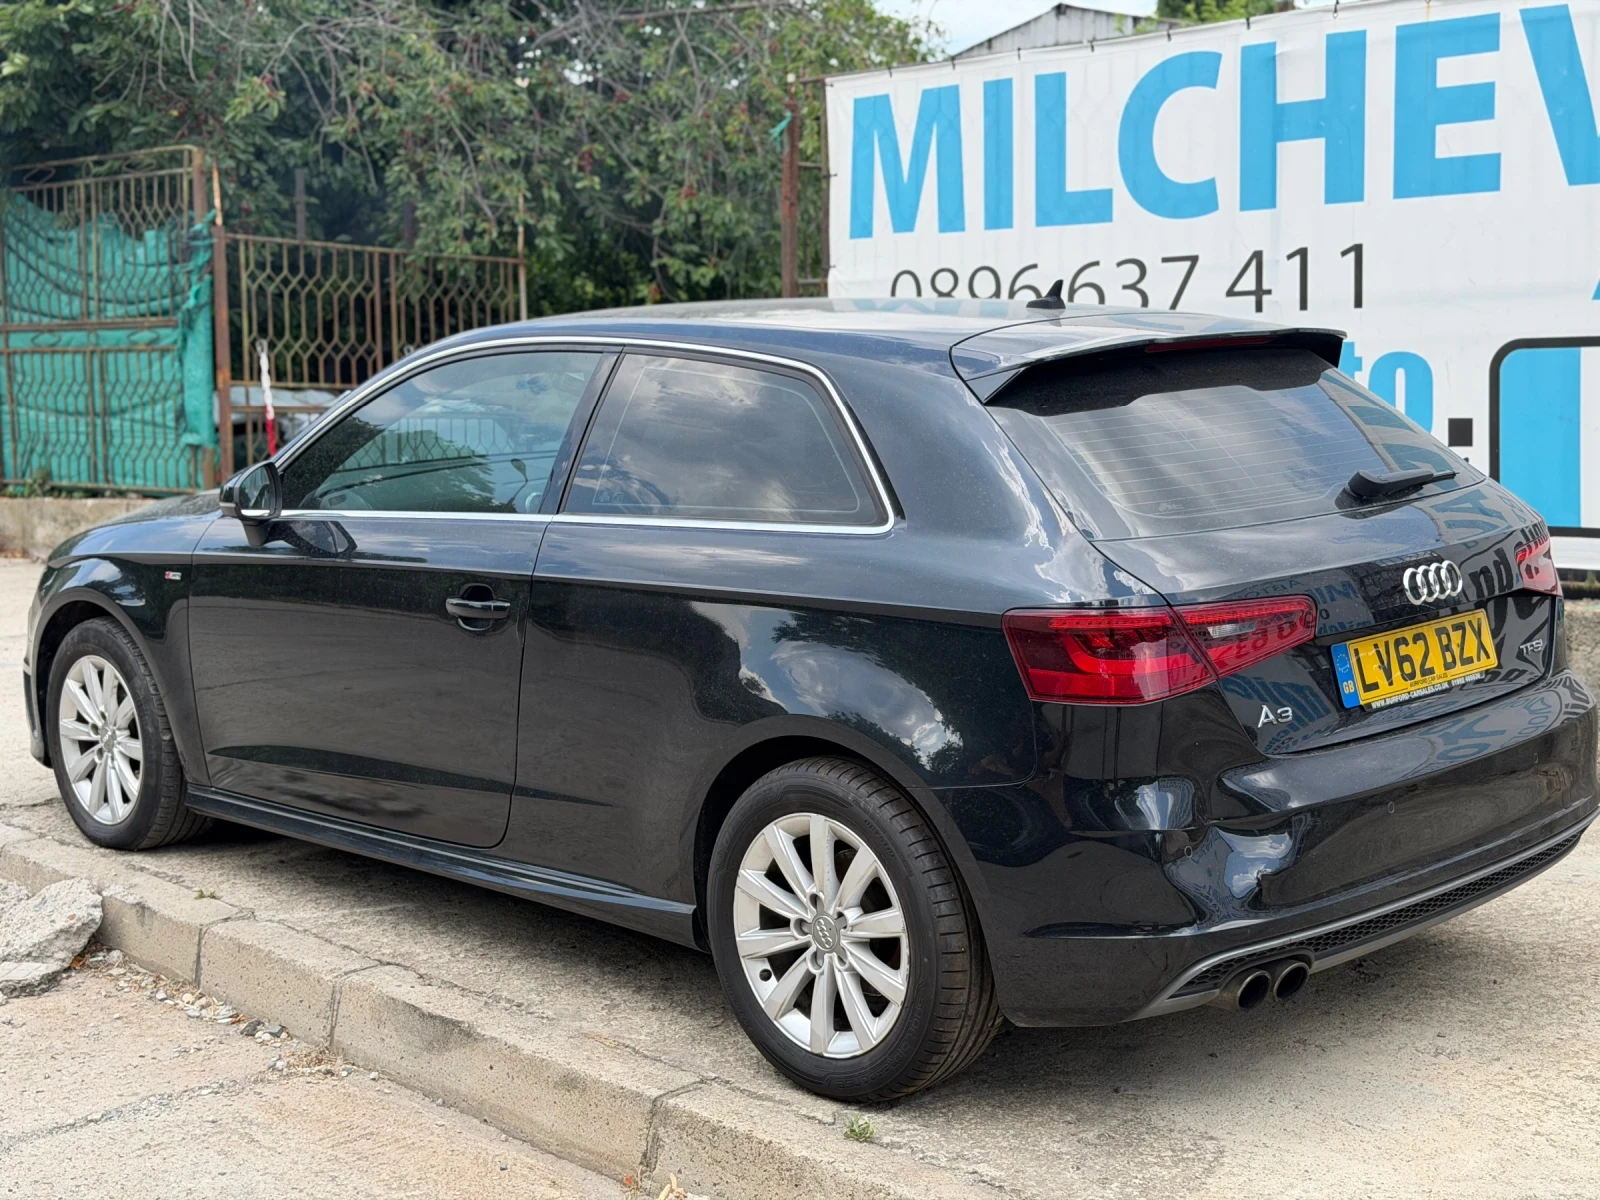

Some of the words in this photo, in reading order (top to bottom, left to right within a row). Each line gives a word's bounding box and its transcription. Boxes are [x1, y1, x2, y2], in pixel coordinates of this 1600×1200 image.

[1067, 255, 1200, 310] 637
[1225, 243, 1365, 313] 411
[1353, 632, 1436, 694] LV62
[1434, 618, 1491, 671] BZX
[1519, 638, 1543, 657] TFSI
[1436, 672, 1448, 680] SALES
[1342, 680, 1355, 694] GB
[1257, 704, 1293, 728] A3
